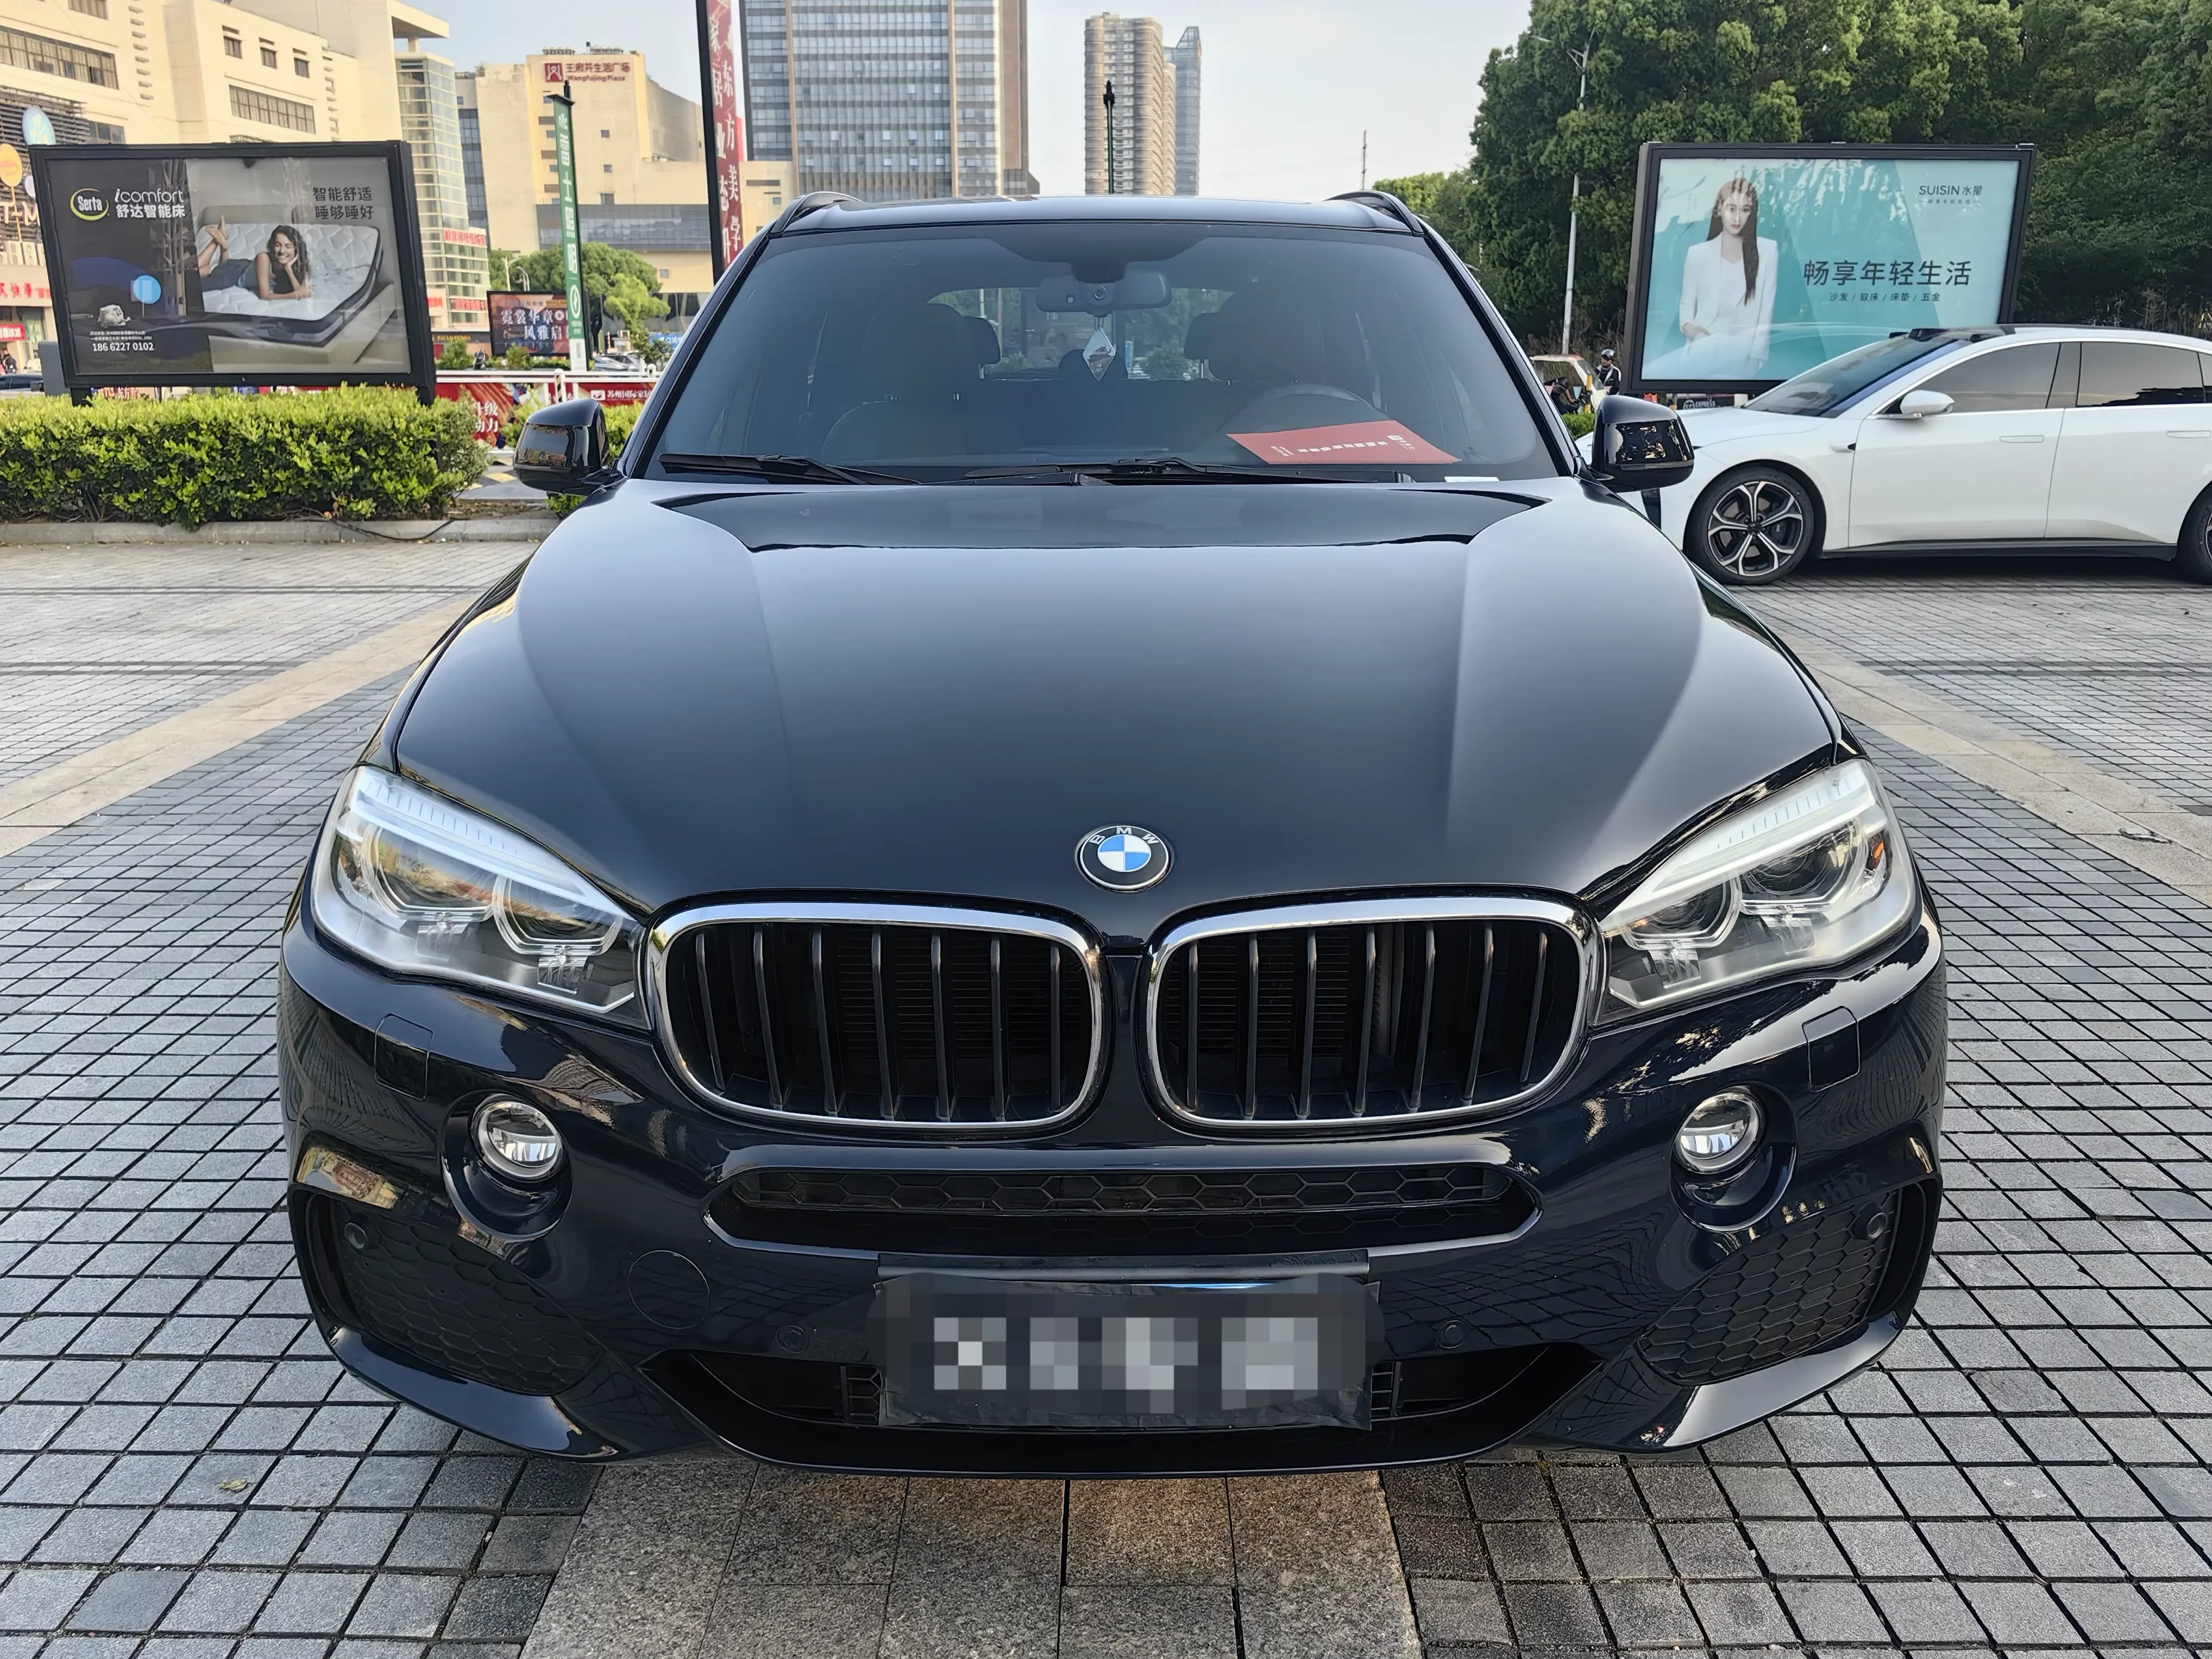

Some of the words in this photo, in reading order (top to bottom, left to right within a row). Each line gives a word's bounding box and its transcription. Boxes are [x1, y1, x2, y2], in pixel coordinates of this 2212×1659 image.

[723, 59, 741, 252] 东方美学
[114, 188, 184, 203] icomfort
[313, 186, 373, 201] 智能舒适
[1919, 185, 1960, 195] SUISIN
[77, 195, 103, 211] Serta
[560, 133, 578, 274] 雷士照明
[116, 204, 186, 218] 舒达智能床
[315, 205, 374, 220] 睡够睡好
[1803, 259, 1972, 286] 畅享年轻生活
[524, 324, 568, 340] 风雅启
[92, 343, 108, 352] 186
[109, 342, 131, 352] 6227
[132, 342, 154, 351] 0102
[1089, 827, 1159, 845] BMW
